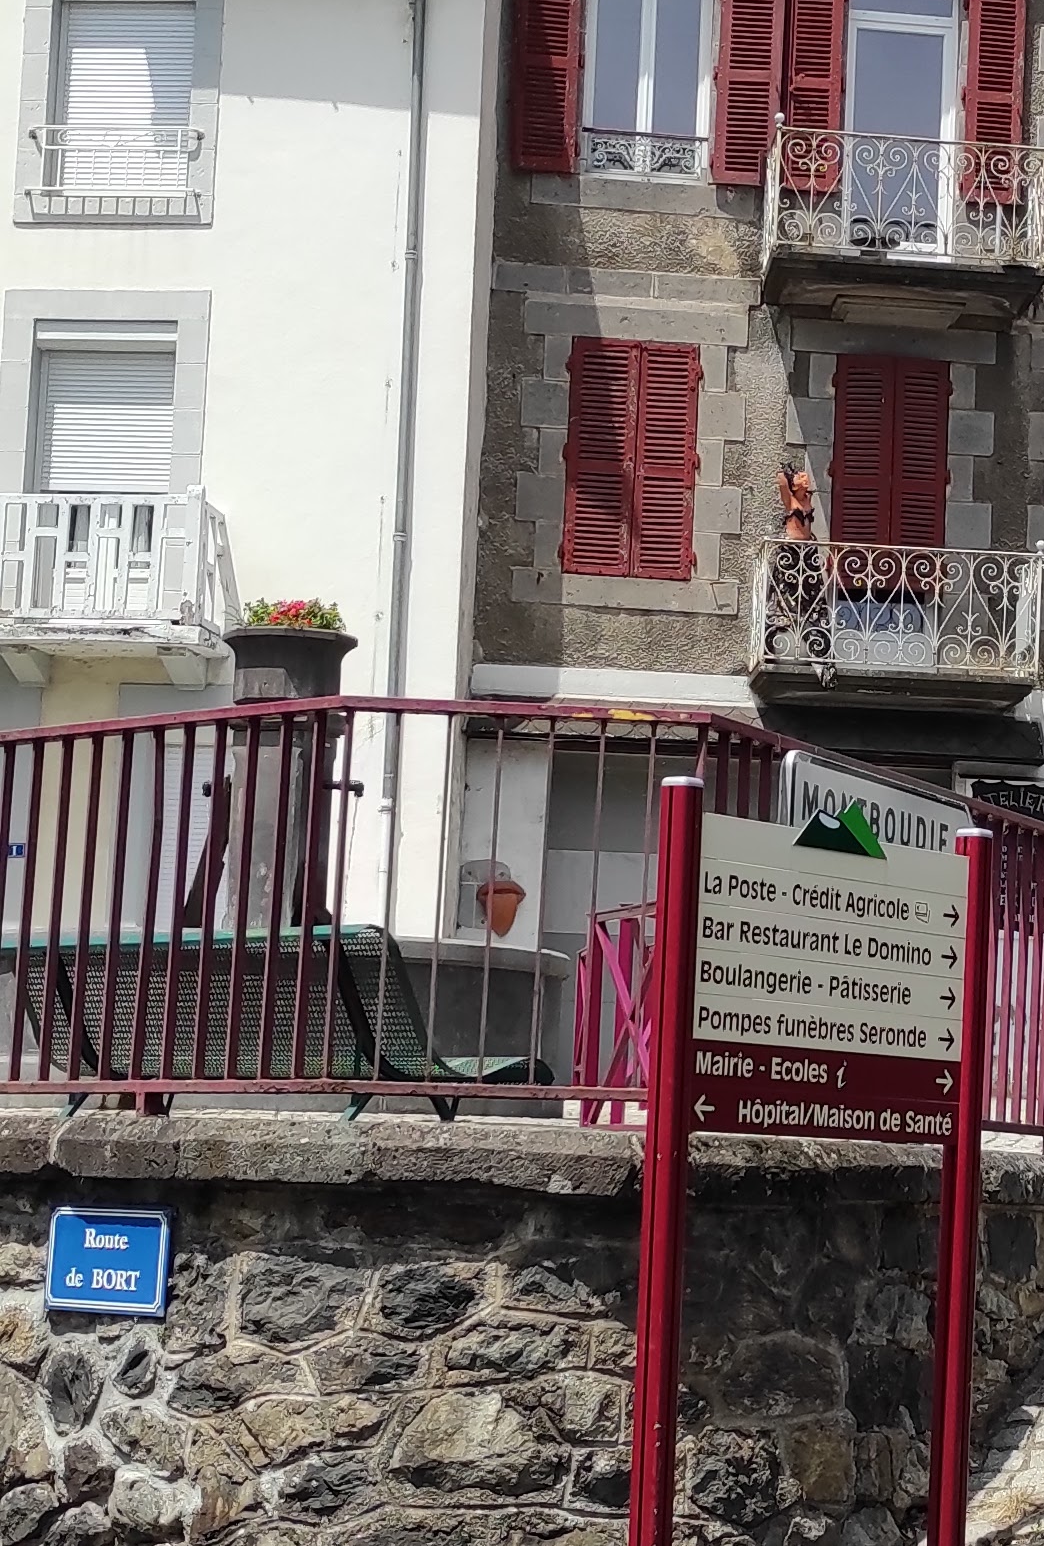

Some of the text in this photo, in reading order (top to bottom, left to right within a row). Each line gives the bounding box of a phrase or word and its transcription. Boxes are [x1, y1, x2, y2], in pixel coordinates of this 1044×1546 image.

[703, 871, 722, 895] La
[728, 874, 777, 902] Poste
[792, 884, 842, 912] Crédit
[845, 891, 910, 921] Agricole
[702, 916, 932, 966] Bar Restaurant Le Domino
[700, 960, 812, 994] Boulangerie
[829, 976, 911, 1005] Pâtisserie
[698, 1006, 927, 1048] Pompes funèbres Seronde
[695, 1051, 754, 1078] Mairie
[770, 1056, 828, 1084] Ecoles
[738, 1099, 952, 1136] Hôpital/Maison de Santé
[84, 1228, 129, 1250] Route
[65, 1267, 140, 1291] de BORT
